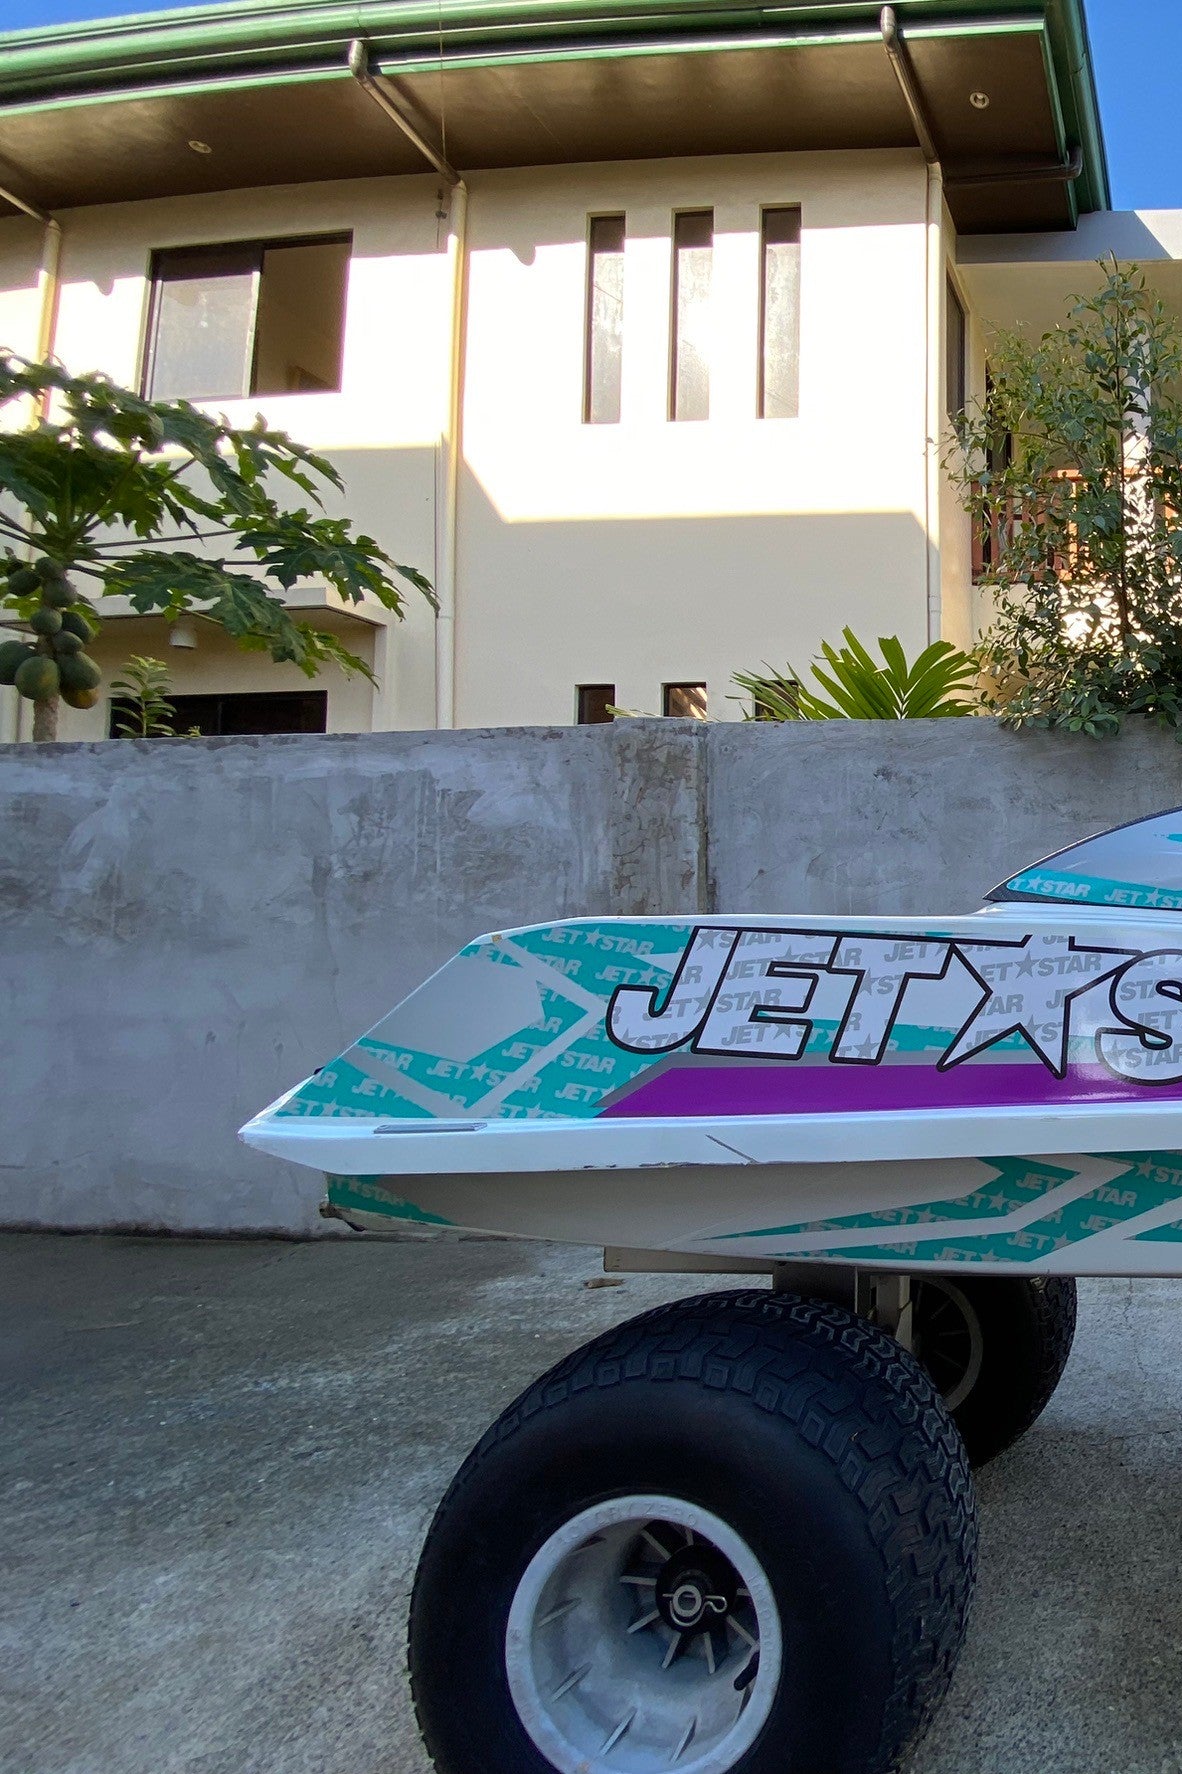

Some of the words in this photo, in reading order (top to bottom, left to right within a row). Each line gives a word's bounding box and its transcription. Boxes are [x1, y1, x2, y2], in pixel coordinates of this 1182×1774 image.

[1043, 880, 1092, 899] STAR
[1104, 888, 1143, 905] JET
[541, 926, 583, 946] JET
[599, 938, 655, 956] STAR
[884, 942, 928, 961] JET
[595, 964, 638, 983] JET
[726, 956, 769, 981] JET
[1038, 952, 1102, 977] STAR
[605, 925, 952, 1066] JET
[716, 989, 782, 1013] STAR
[721, 1024, 767, 1046] JET
[427, 1060, 470, 1080] JET
[560, 1051, 616, 1074] STAR
[555, 1082, 602, 1101] JET
[1006, 1231, 1051, 1250] JET
[934, 1246, 977, 1261] JET
